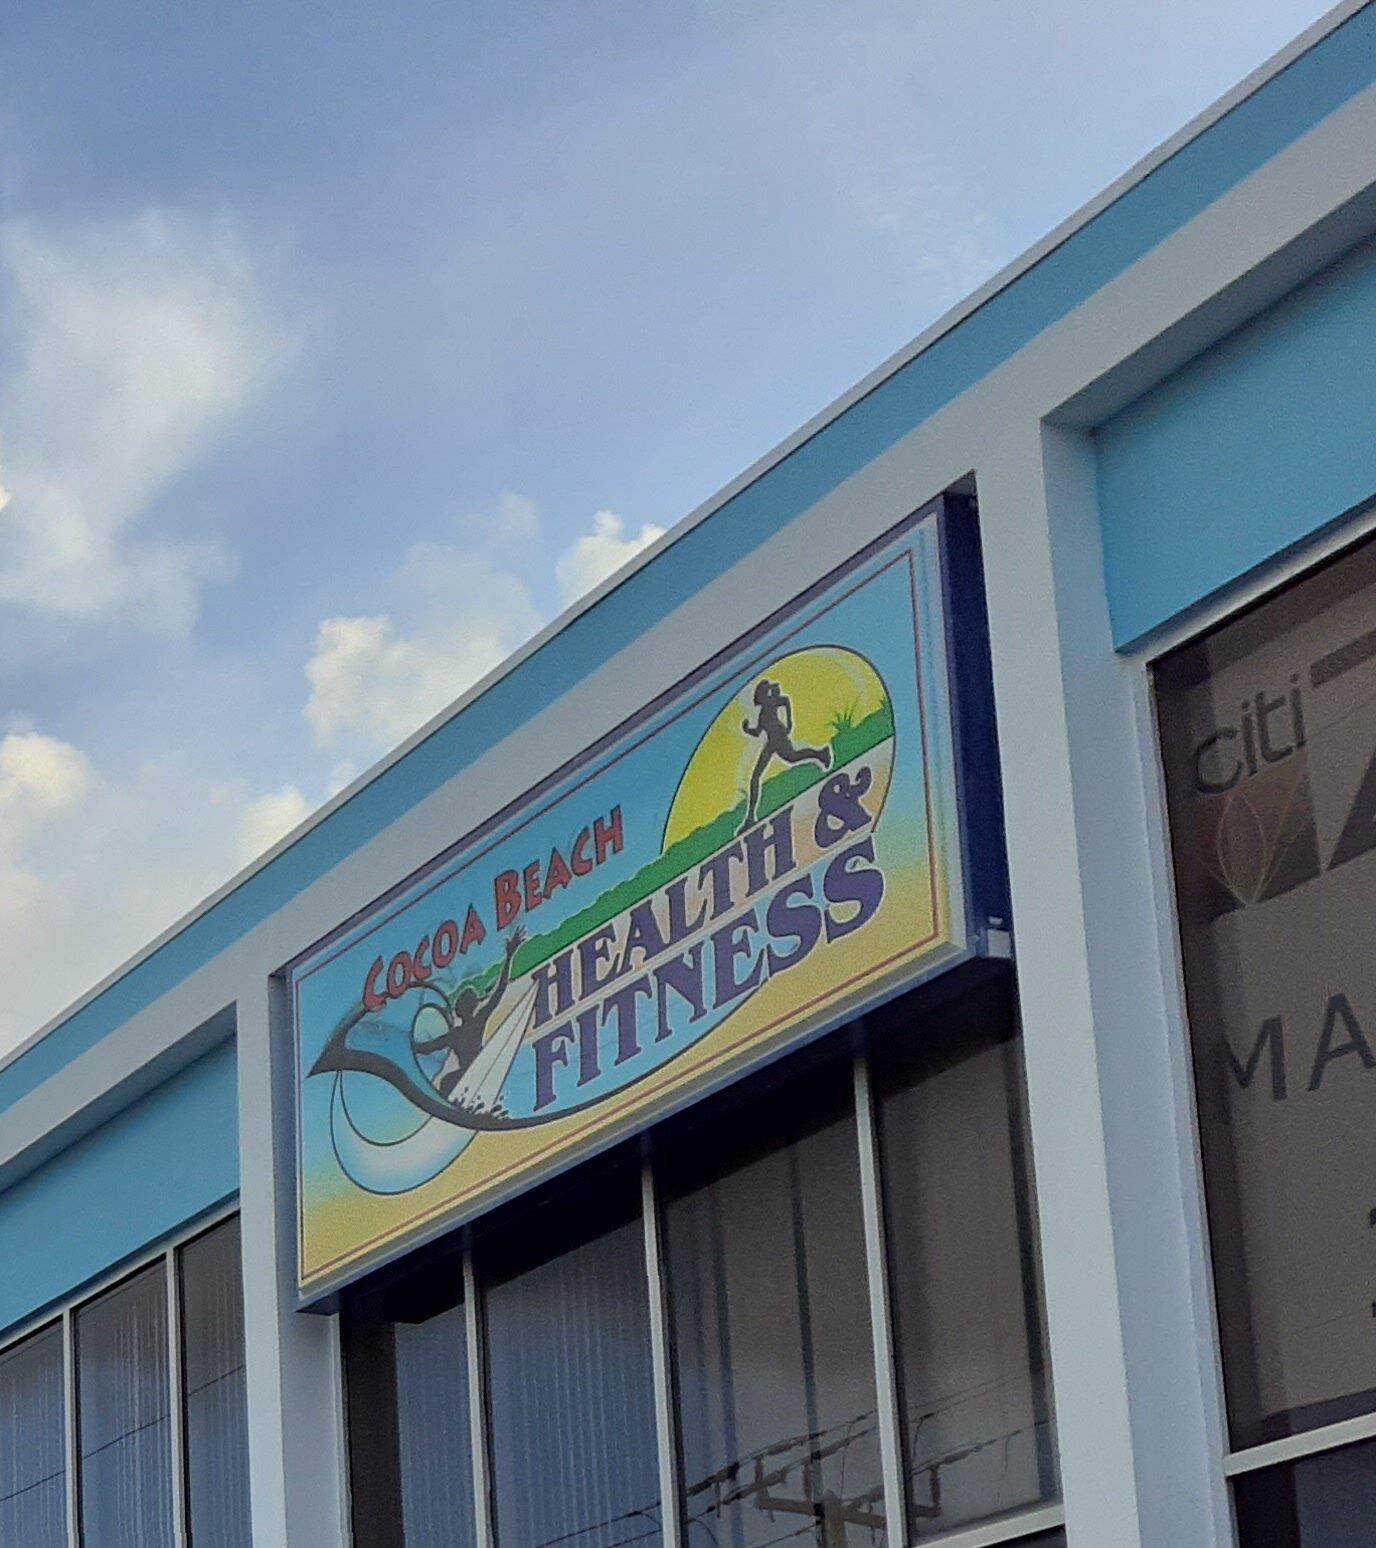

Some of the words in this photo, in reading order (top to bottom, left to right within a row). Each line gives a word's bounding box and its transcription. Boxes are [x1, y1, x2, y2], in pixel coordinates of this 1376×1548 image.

[362, 904, 488, 1012] COCOA
[493, 804, 625, 932] BEACH
[531, 805, 796, 1033] HEALTH
[813, 764, 874, 849] &
[531, 832, 886, 1112] FITNESS
